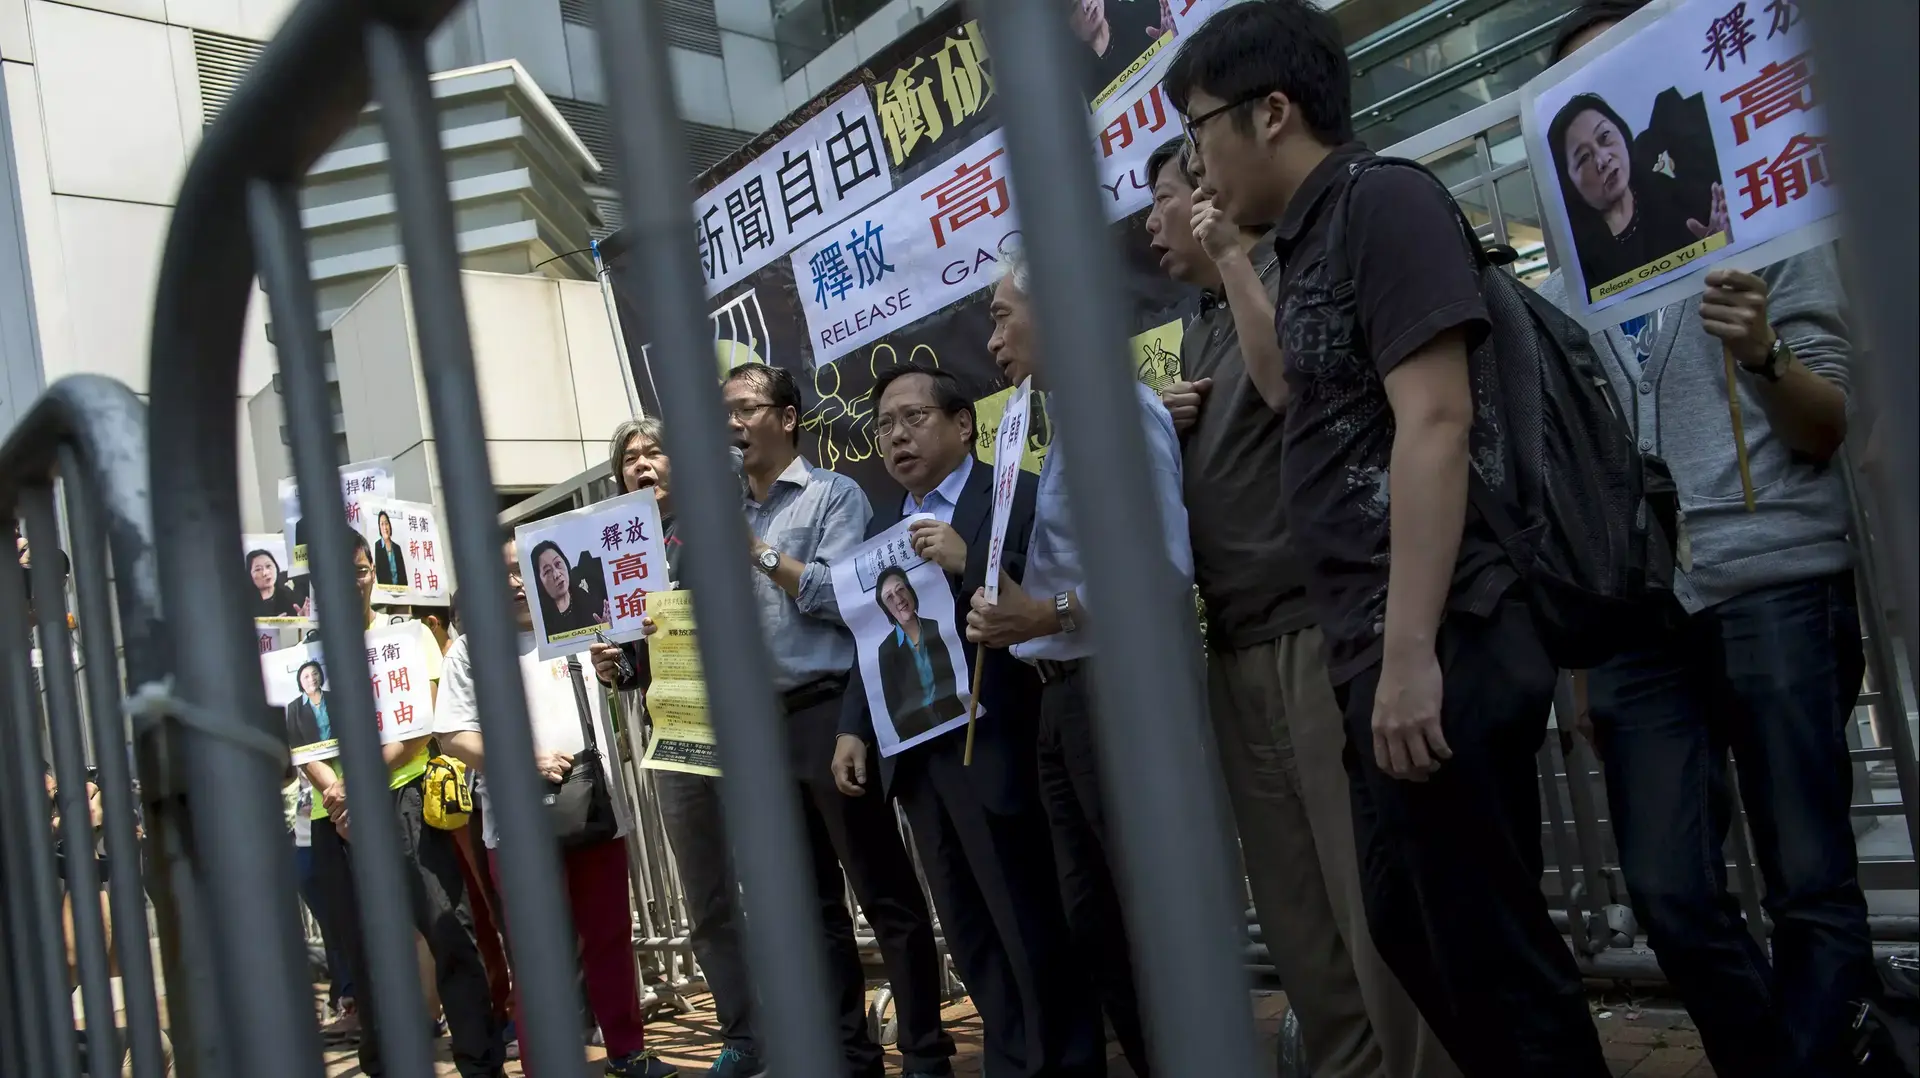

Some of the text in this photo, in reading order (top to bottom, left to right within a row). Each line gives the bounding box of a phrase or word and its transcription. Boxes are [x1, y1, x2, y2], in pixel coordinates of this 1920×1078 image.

[1096, 84, 1118, 105] Release
[1120, 62, 1140, 83] GAO
[1142, 48, 1155, 61] YU
[698, 110, 881, 280] 新聞自由
[1600, 277, 1634, 296] Release
[1638, 260, 1671, 279] GAO
[1676, 248, 1696, 262] YU
[820, 288, 912, 349] RELEASE
[346, 476, 375, 495] 捍衛
[408, 514, 429, 532] 捍衛
[601, 516, 649, 551] 釋放
[409, 538, 435, 562] 新聞
[414, 568, 438, 590] 自由
